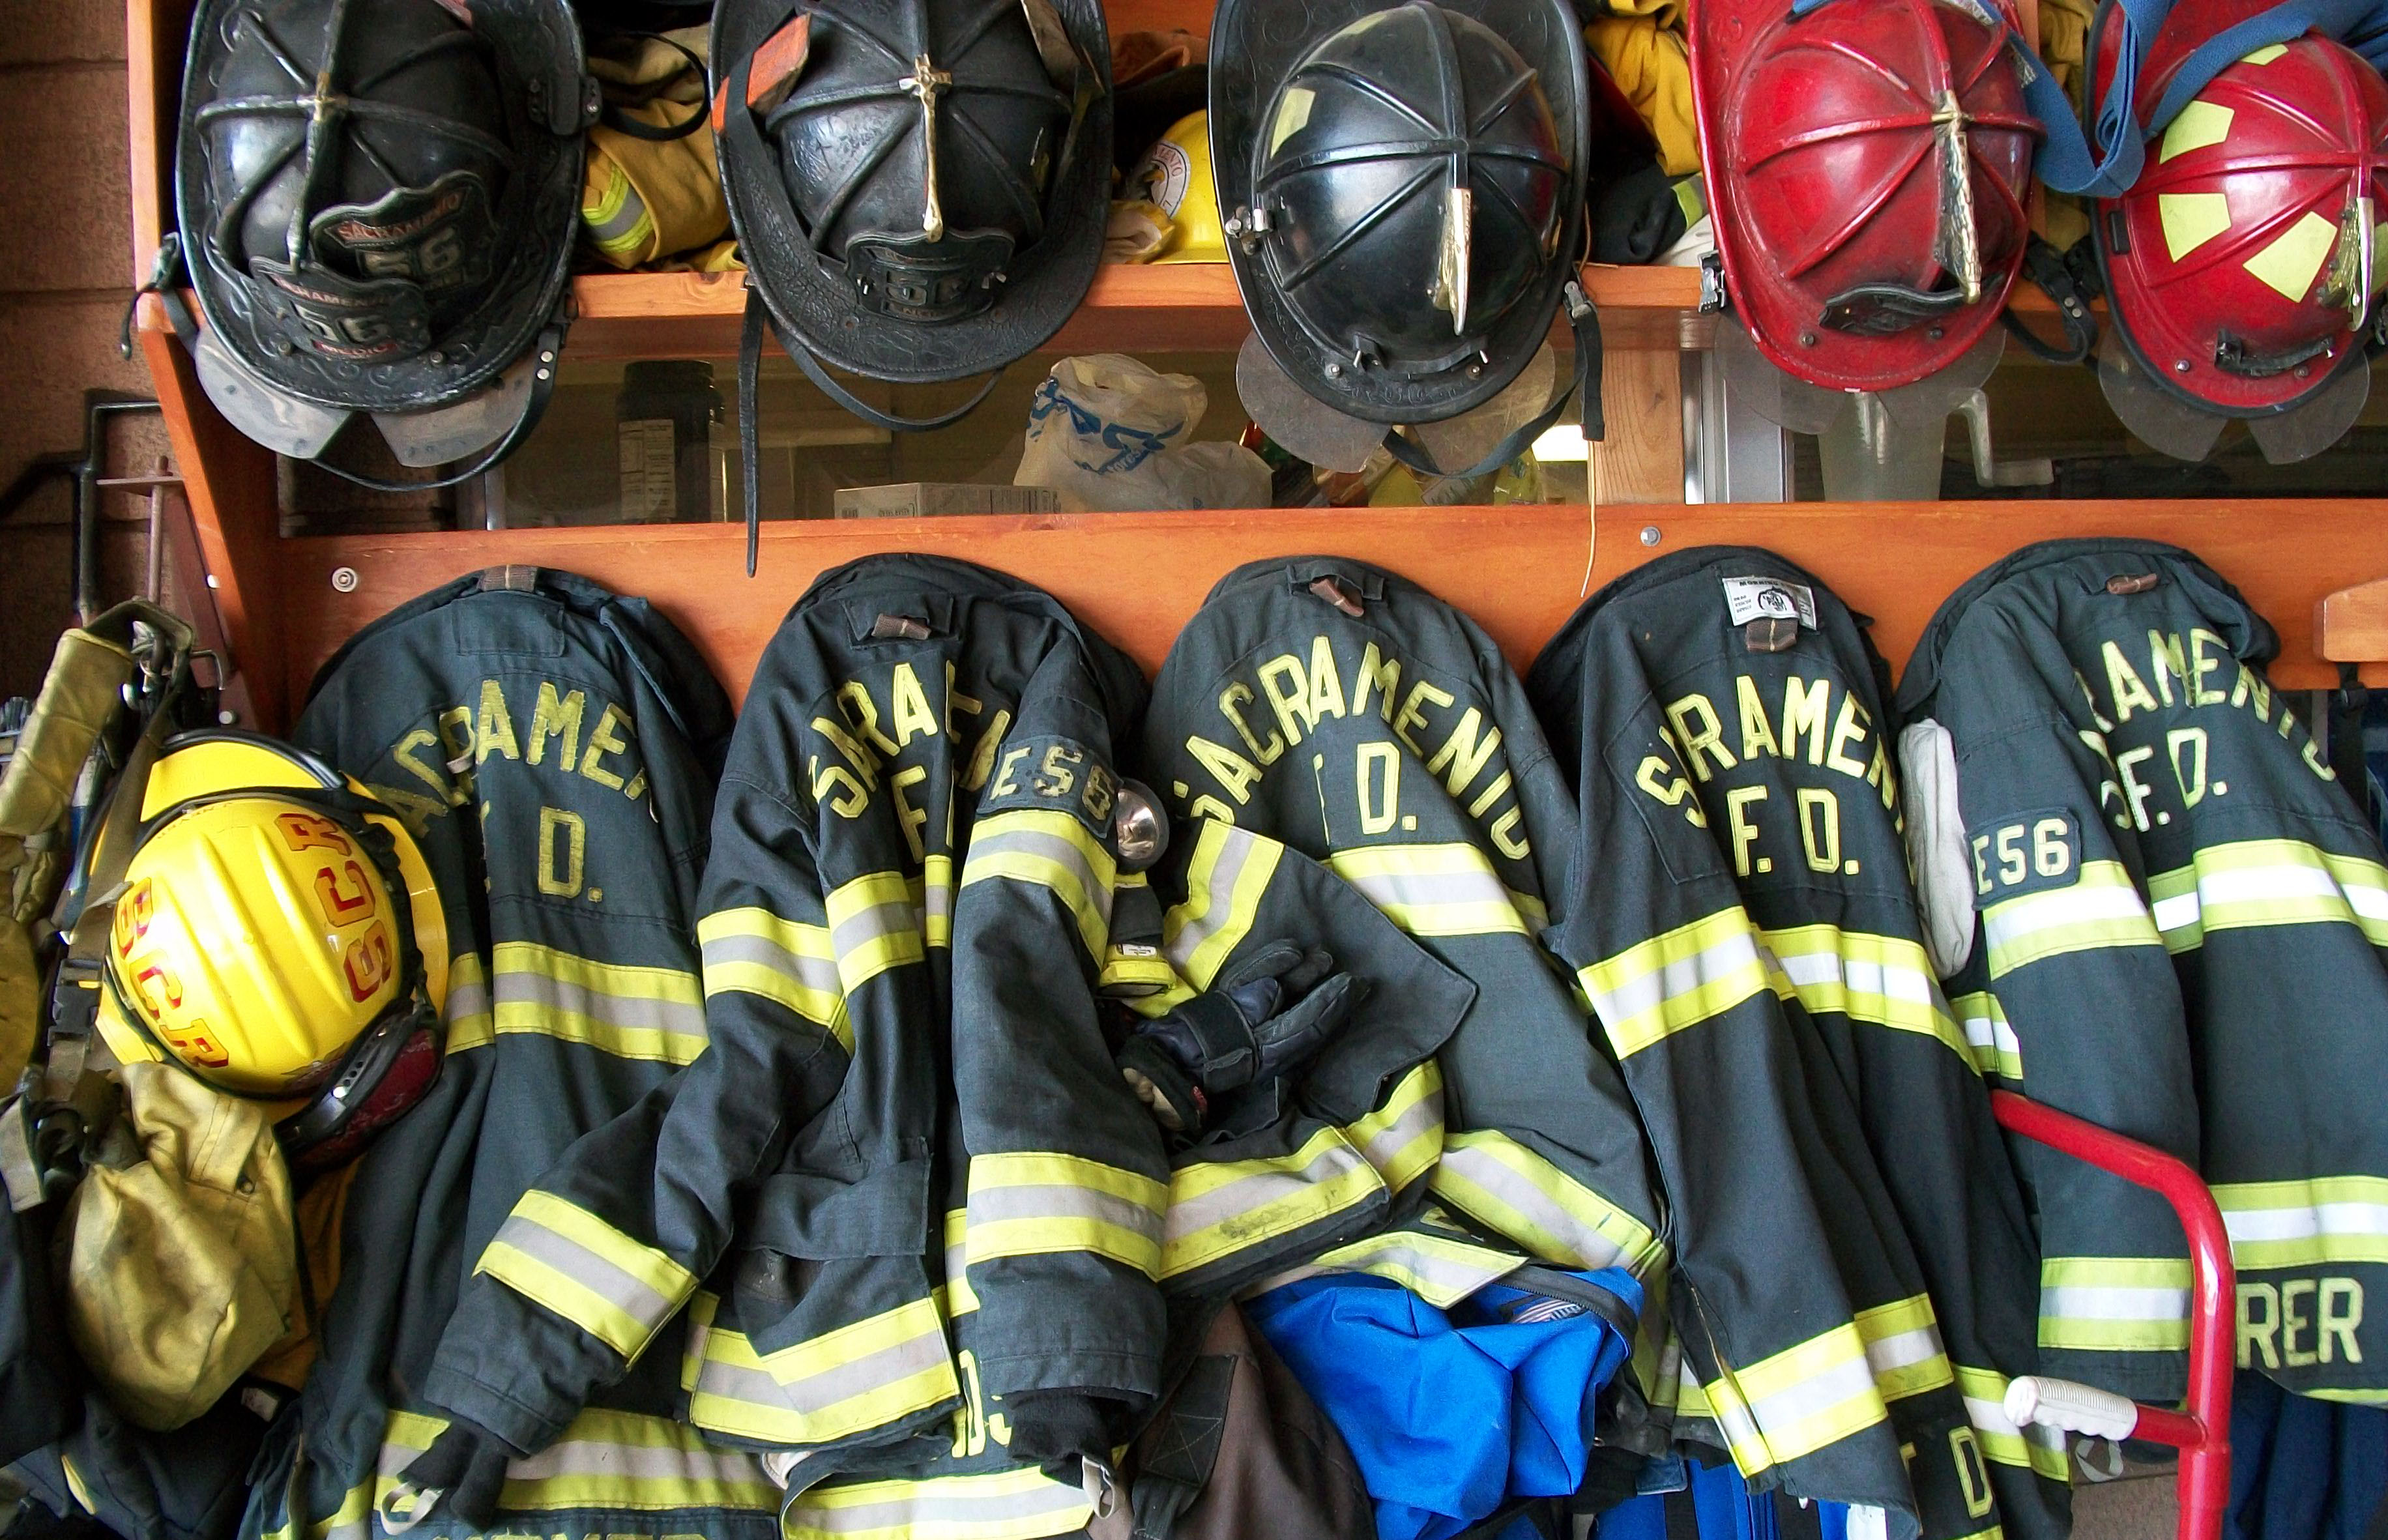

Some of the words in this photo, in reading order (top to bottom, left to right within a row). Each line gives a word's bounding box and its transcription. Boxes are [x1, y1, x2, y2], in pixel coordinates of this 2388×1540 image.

[292, 301, 391, 343] 56
[321, 341, 388, 356] MEDIC
[1972, 817, 2069, 895] E56
[274, 813, 392, 1003] SCR
[113, 877, 229, 1069] SCR
